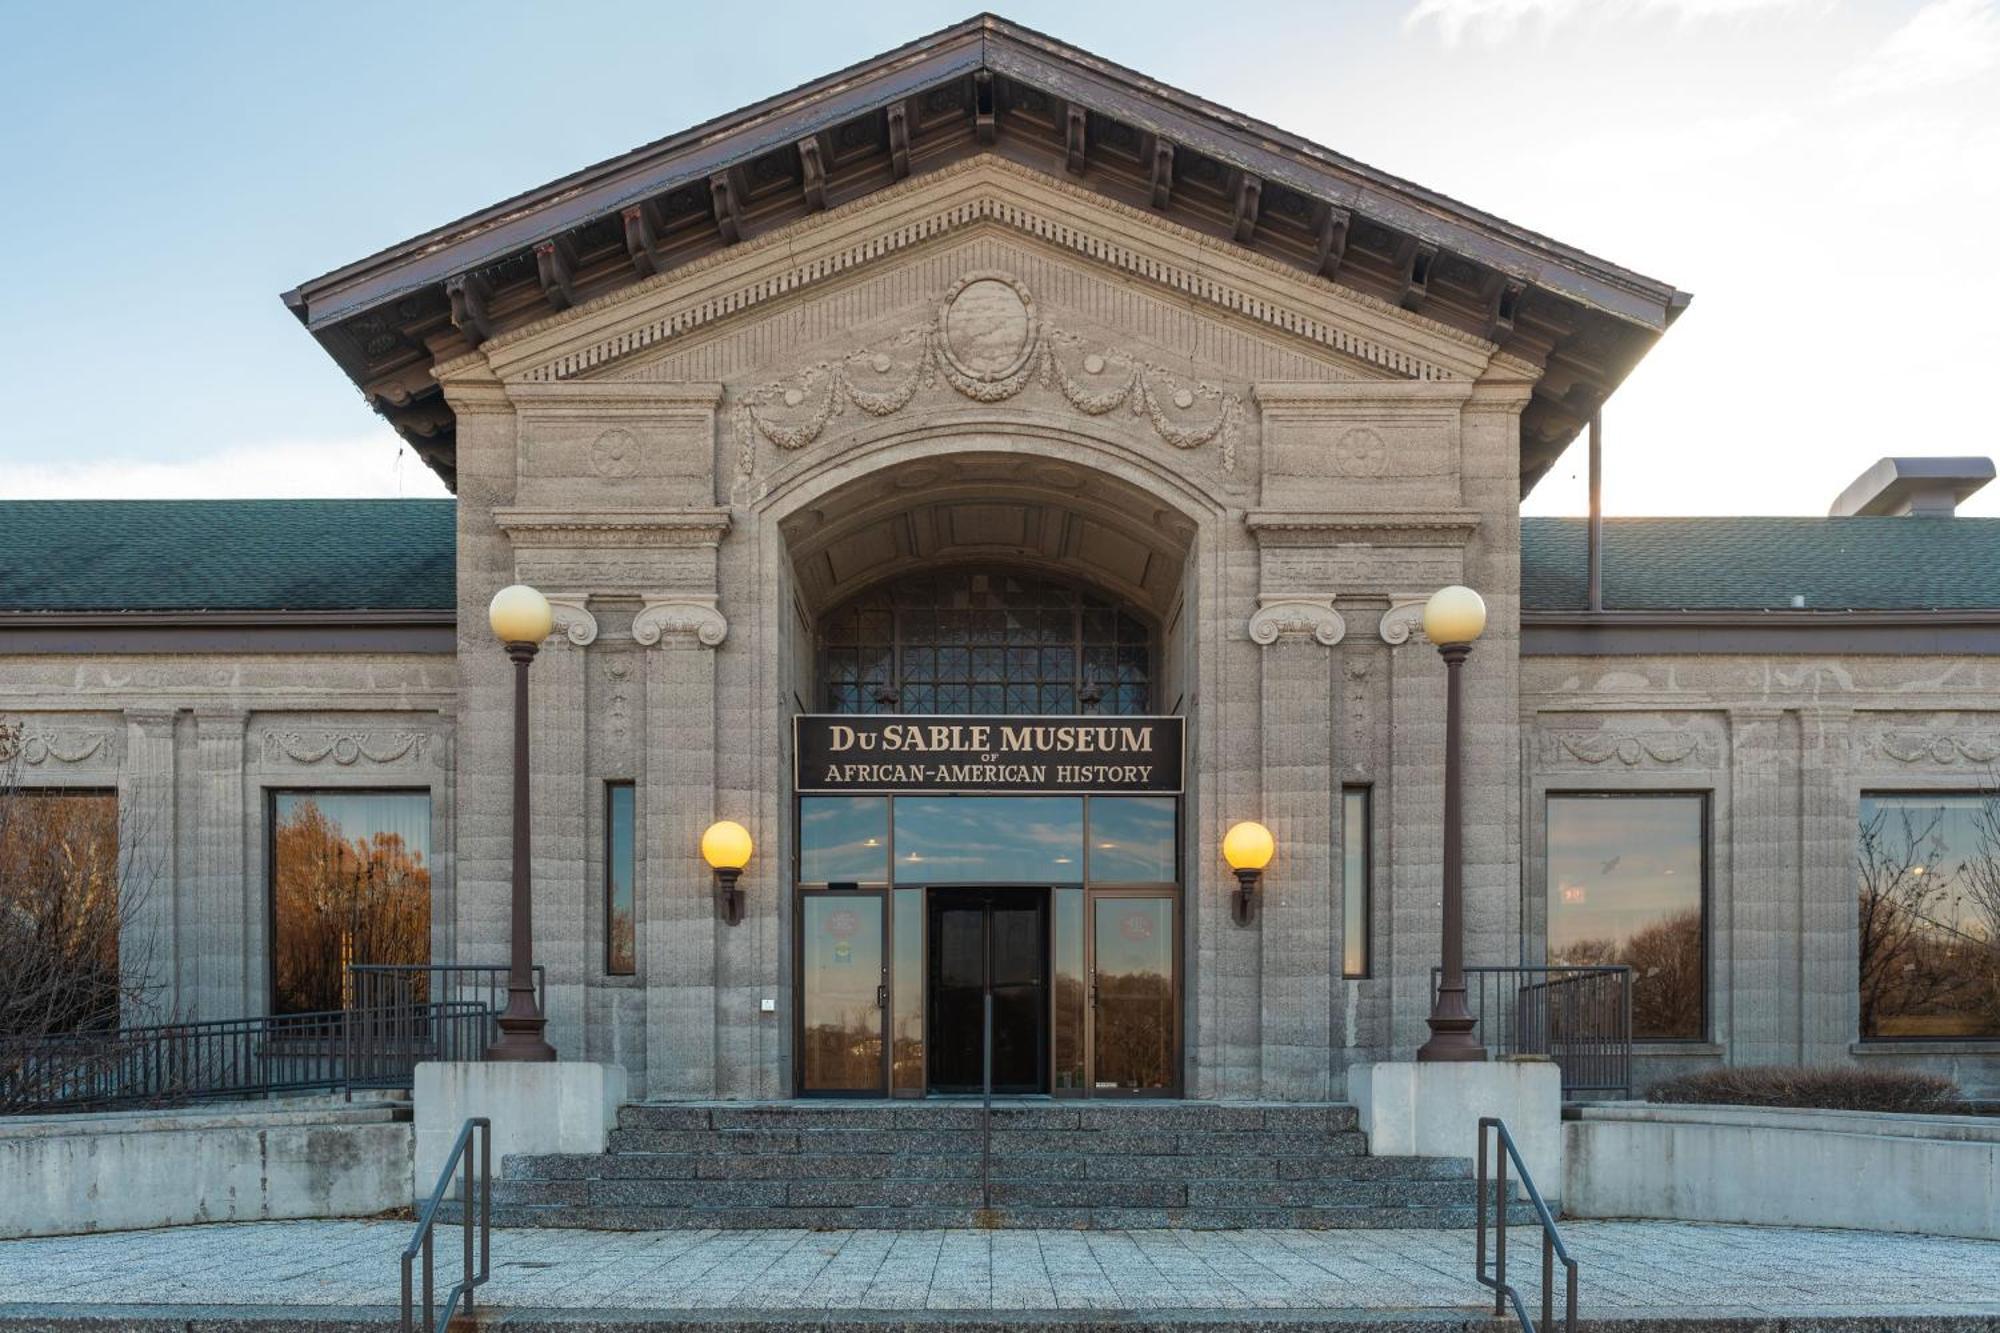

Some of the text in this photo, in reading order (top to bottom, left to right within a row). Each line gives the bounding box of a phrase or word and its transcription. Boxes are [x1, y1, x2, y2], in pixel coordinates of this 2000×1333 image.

[1000, 726, 1153, 752] MUSEUM
[980, 753, 1000, 762] OF
[824, 764, 1153, 783] AFRICAN-AMERICAN HISTORY
